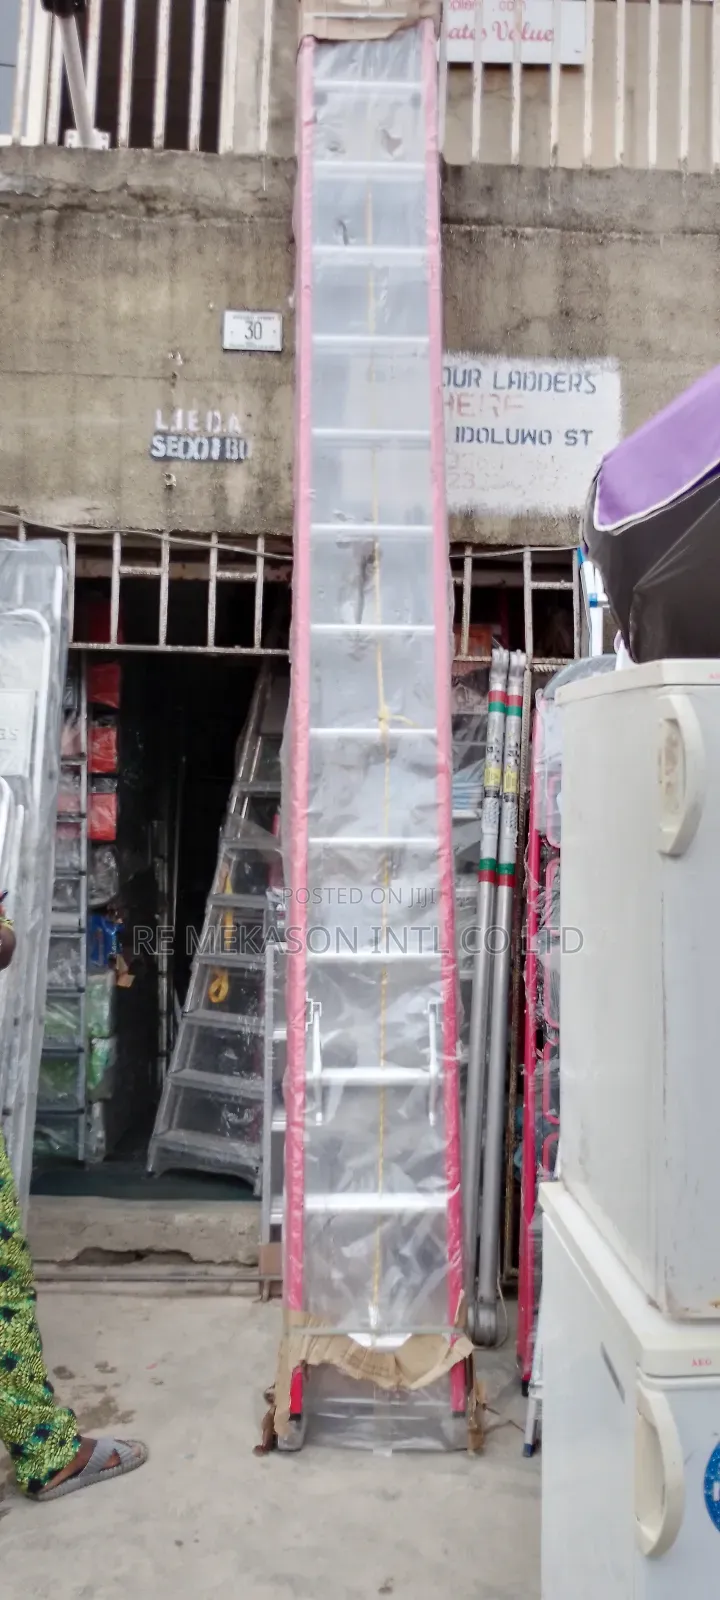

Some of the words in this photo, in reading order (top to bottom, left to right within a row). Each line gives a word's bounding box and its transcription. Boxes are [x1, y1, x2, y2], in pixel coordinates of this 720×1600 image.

[244, 320, 262, 340] 30
[493, 369, 597, 395] LADDERS
[455, 425, 553, 446] IDOLUWO
[564, 427, 594, 446] ST
